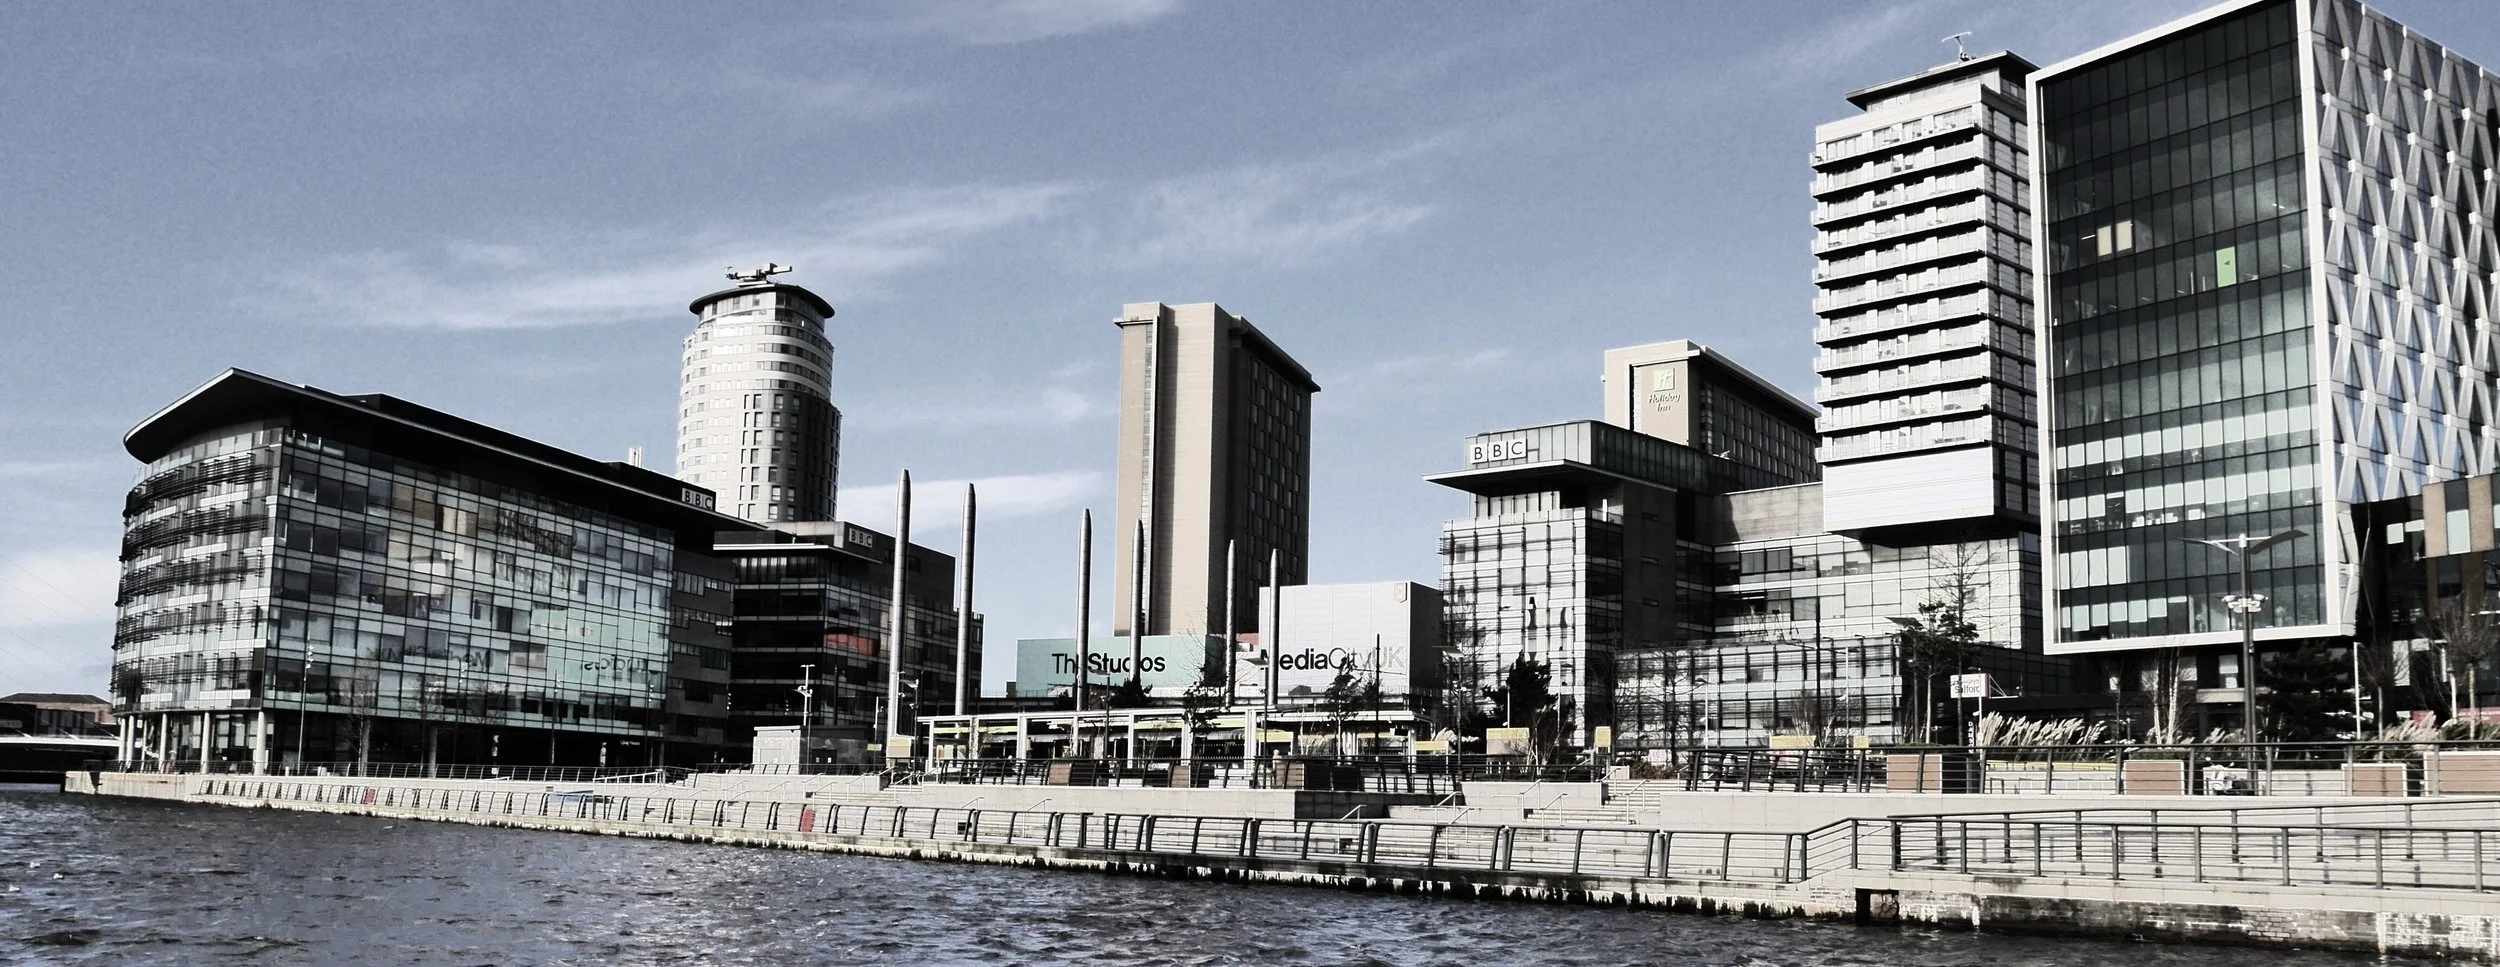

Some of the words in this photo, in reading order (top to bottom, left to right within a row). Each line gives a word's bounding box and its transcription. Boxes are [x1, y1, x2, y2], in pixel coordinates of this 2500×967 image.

[1648, 393, 1681, 404] Holiday
[1657, 403, 1672, 412] Inn
[1474, 441, 1523, 460] BBC
[684, 490, 712, 509] BBC
[851, 530, 872, 546] BBC
[1051, 653, 1078, 674] Th
[1088, 652, 1165, 674] Stuos
[1954, 684, 1981, 694] Slford
